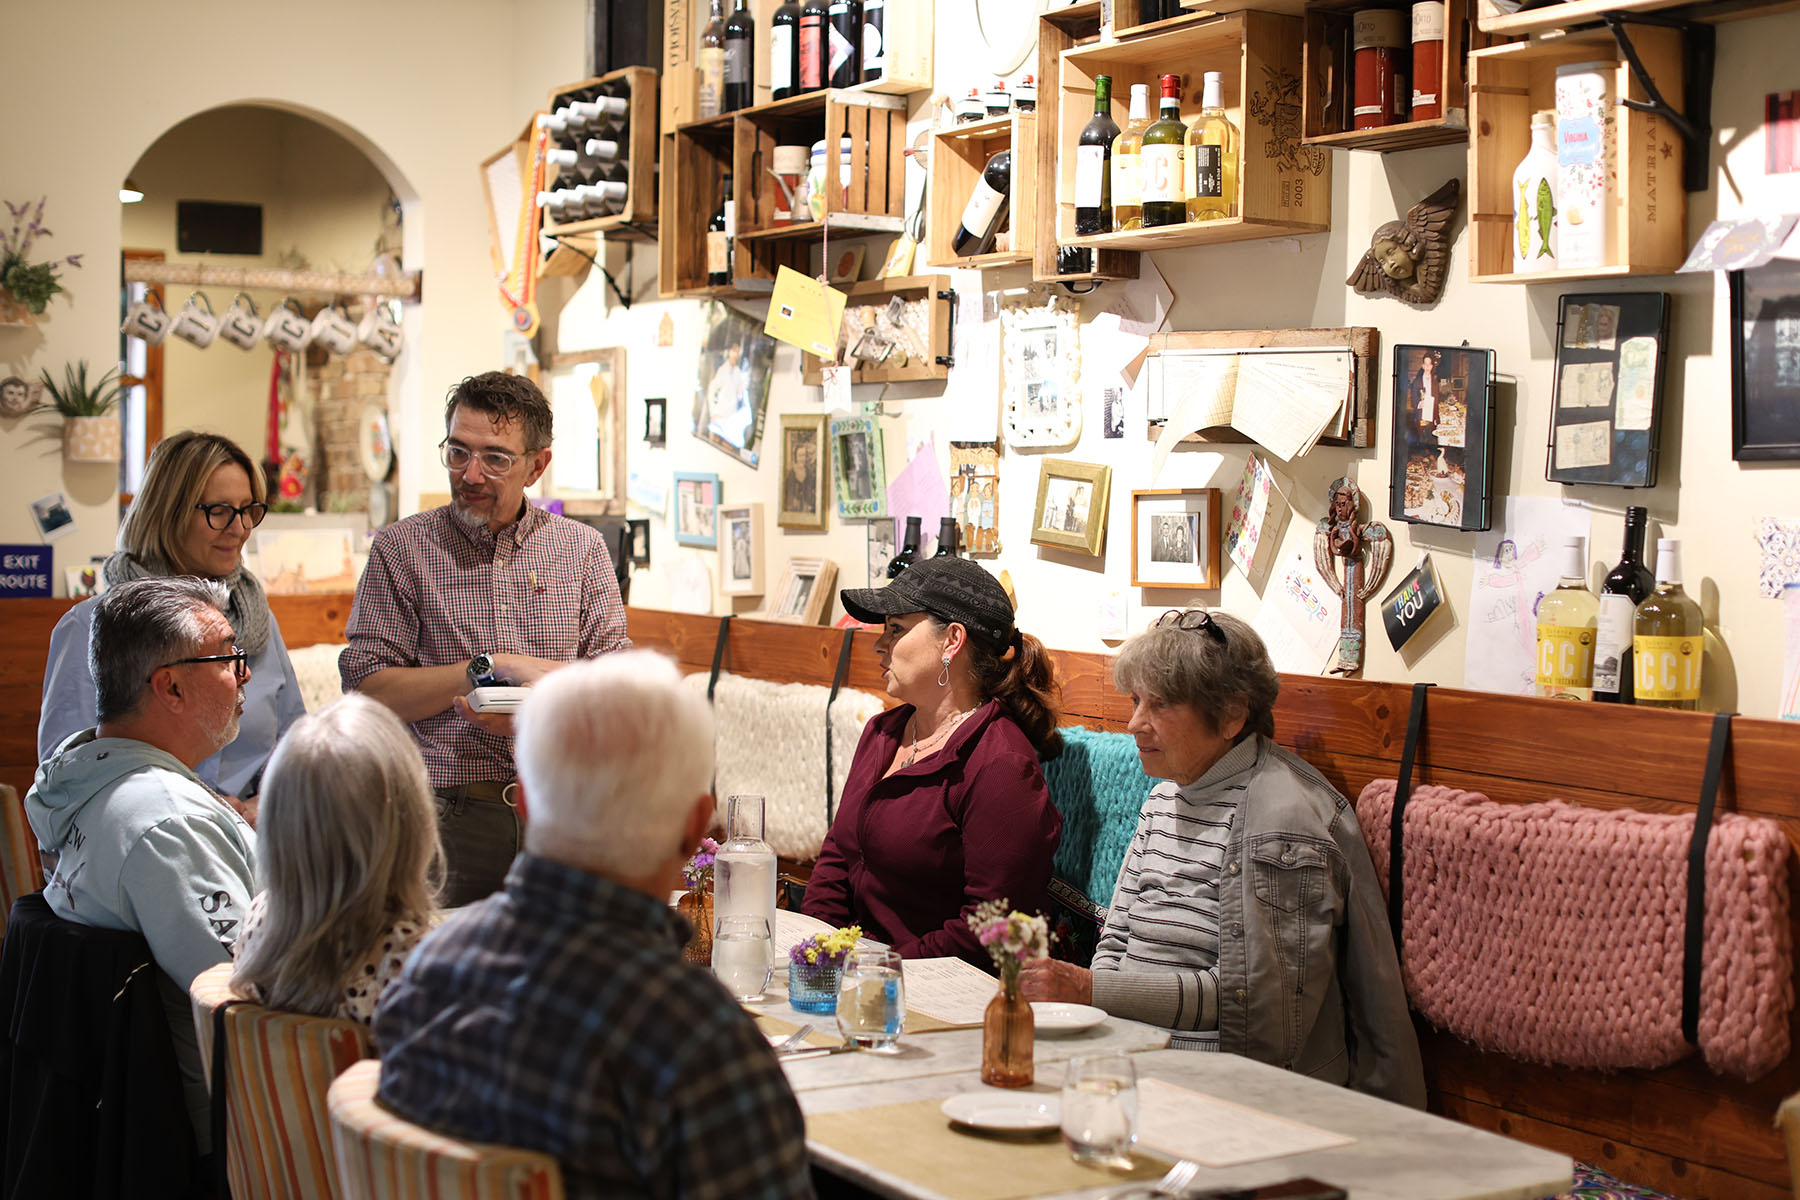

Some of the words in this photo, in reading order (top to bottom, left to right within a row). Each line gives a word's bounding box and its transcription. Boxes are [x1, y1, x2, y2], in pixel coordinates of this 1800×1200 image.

[1294, 178, 1304, 207] 2003
[3, 554, 40, 570] EXIT
[0, 574, 47, 590] ROUTE
[1393, 578, 1420, 613] THANK
[1396, 590, 1424, 627] YOU
